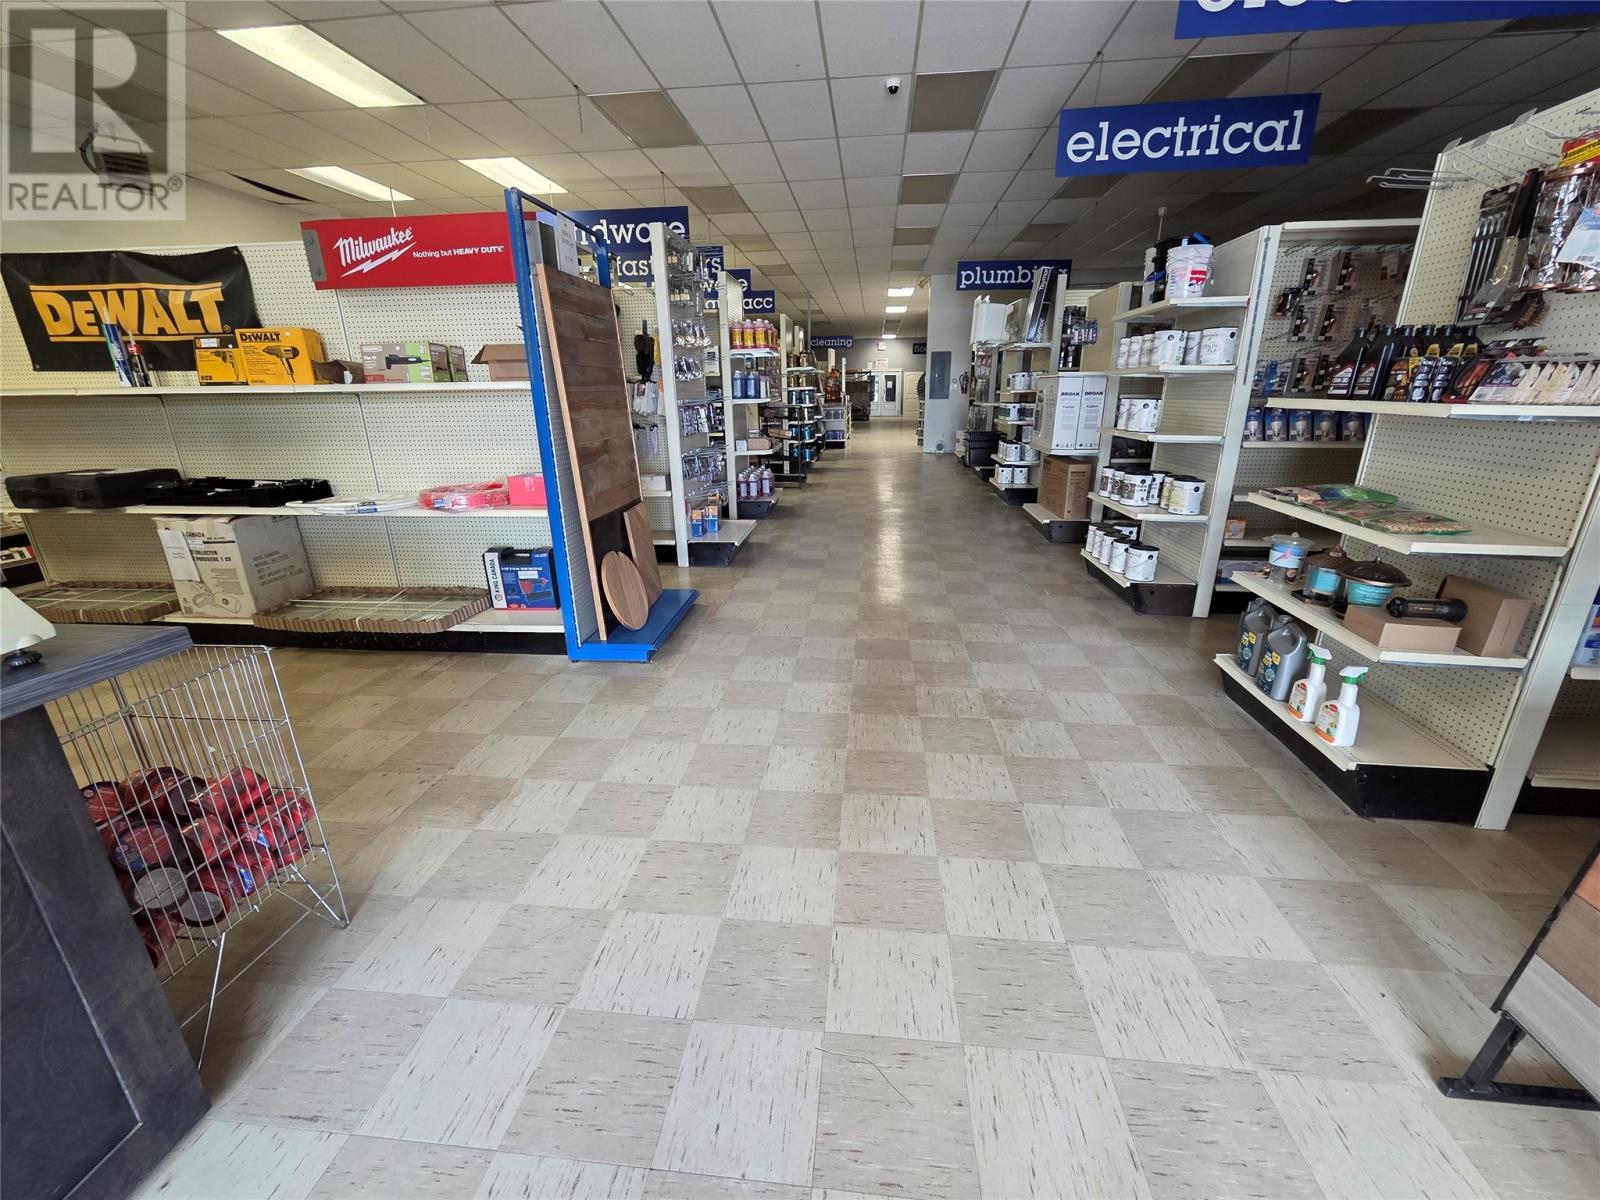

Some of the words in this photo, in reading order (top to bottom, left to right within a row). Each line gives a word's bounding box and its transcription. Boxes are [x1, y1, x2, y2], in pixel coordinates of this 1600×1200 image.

[1066, 109, 1302, 163] electrical
[333, 227, 415, 267] Milwaukee
[413, 250, 440, 259] Nothing
[440, 249, 453, 257] but
[453, 248, 479, 256] HEAVY
[810, 337, 853, 348] cleaning
